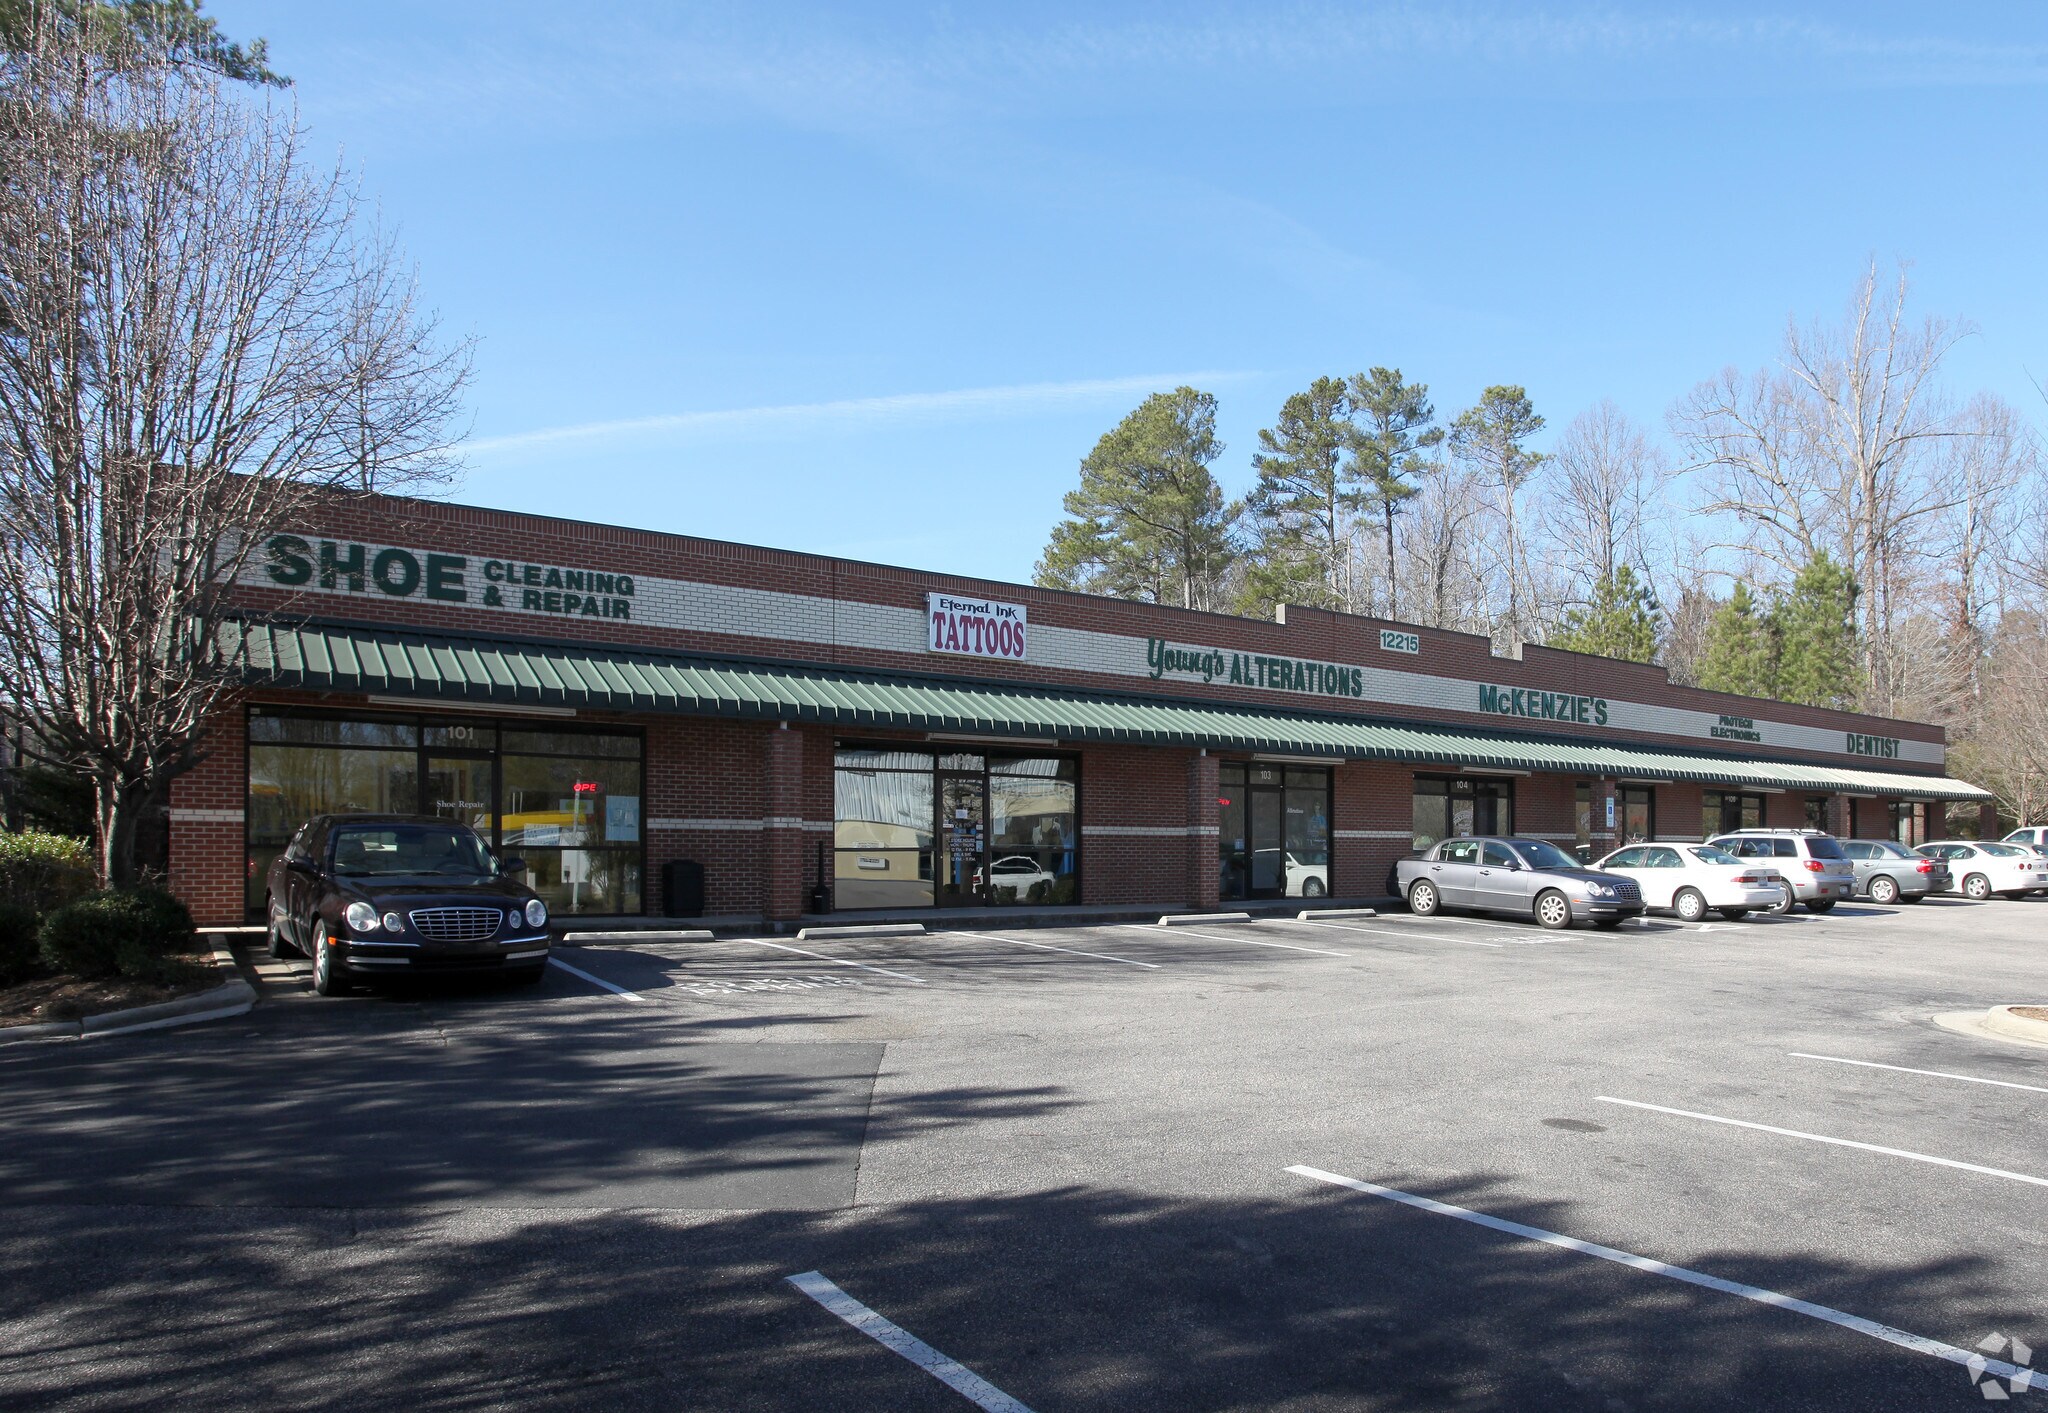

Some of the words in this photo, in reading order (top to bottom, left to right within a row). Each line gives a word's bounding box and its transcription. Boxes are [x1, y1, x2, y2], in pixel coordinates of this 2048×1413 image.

[267, 534, 467, 602] SHOE
[484, 560, 635, 597] CLEANING
[483, 585, 504, 608] &
[523, 589, 631, 620] REPAIR
[940, 598, 990, 614] Eternal
[996, 604, 1018, 620] Ink
[932, 611, 1024, 657] TATTOOS
[1380, 632, 1418, 652] 12215
[1148, 636, 1225, 683] Young's
[1230, 653, 1363, 698] ALTERATIONS
[1719, 715, 1753, 729] PROTECH
[448, 726, 474, 740] 101
[1710, 725, 1761, 743] ELECTRONICS
[1846, 733, 1900, 758] DENTIST
[1260, 770, 1272, 780] 103
[1456, 780, 1468, 789] 104
[436, 800, 456, 808] Shoe
[459, 800, 484, 809] Repair
[689, 978, 863, 996] PARKING
